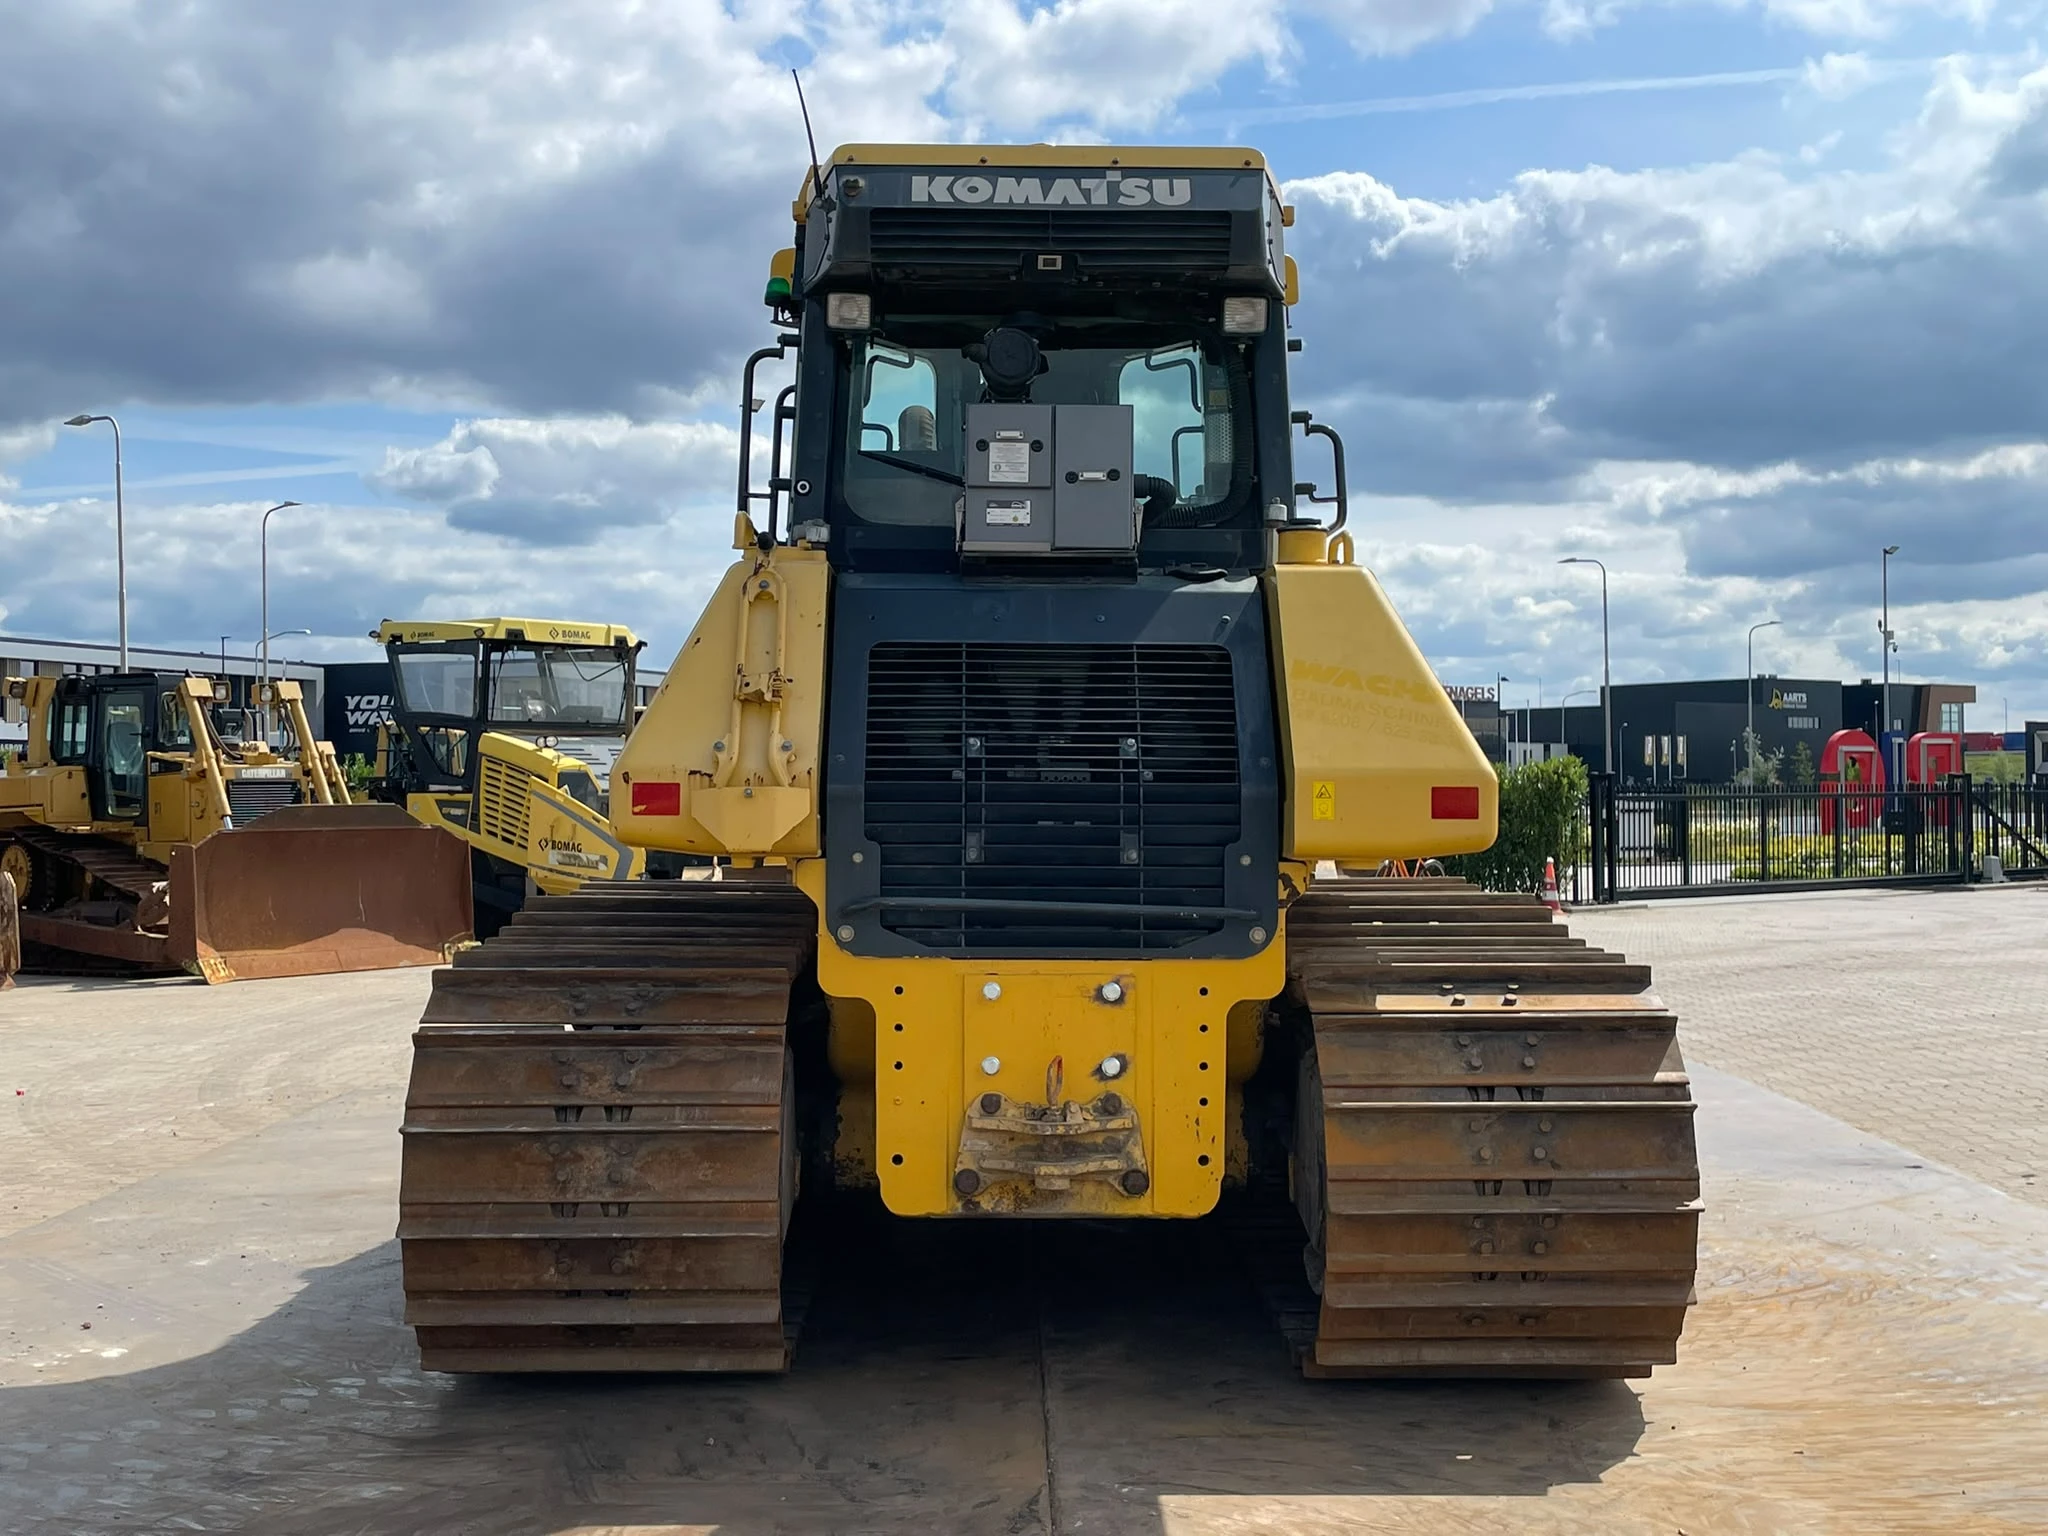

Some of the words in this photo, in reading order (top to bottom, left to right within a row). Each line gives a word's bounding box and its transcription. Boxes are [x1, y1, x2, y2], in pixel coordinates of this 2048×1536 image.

[911, 170, 1191, 206] KOMATSU
[561, 629, 591, 640] BOMAG
[1782, 692, 1807, 704] AARTS
[551, 840, 583, 853] BOMAG
